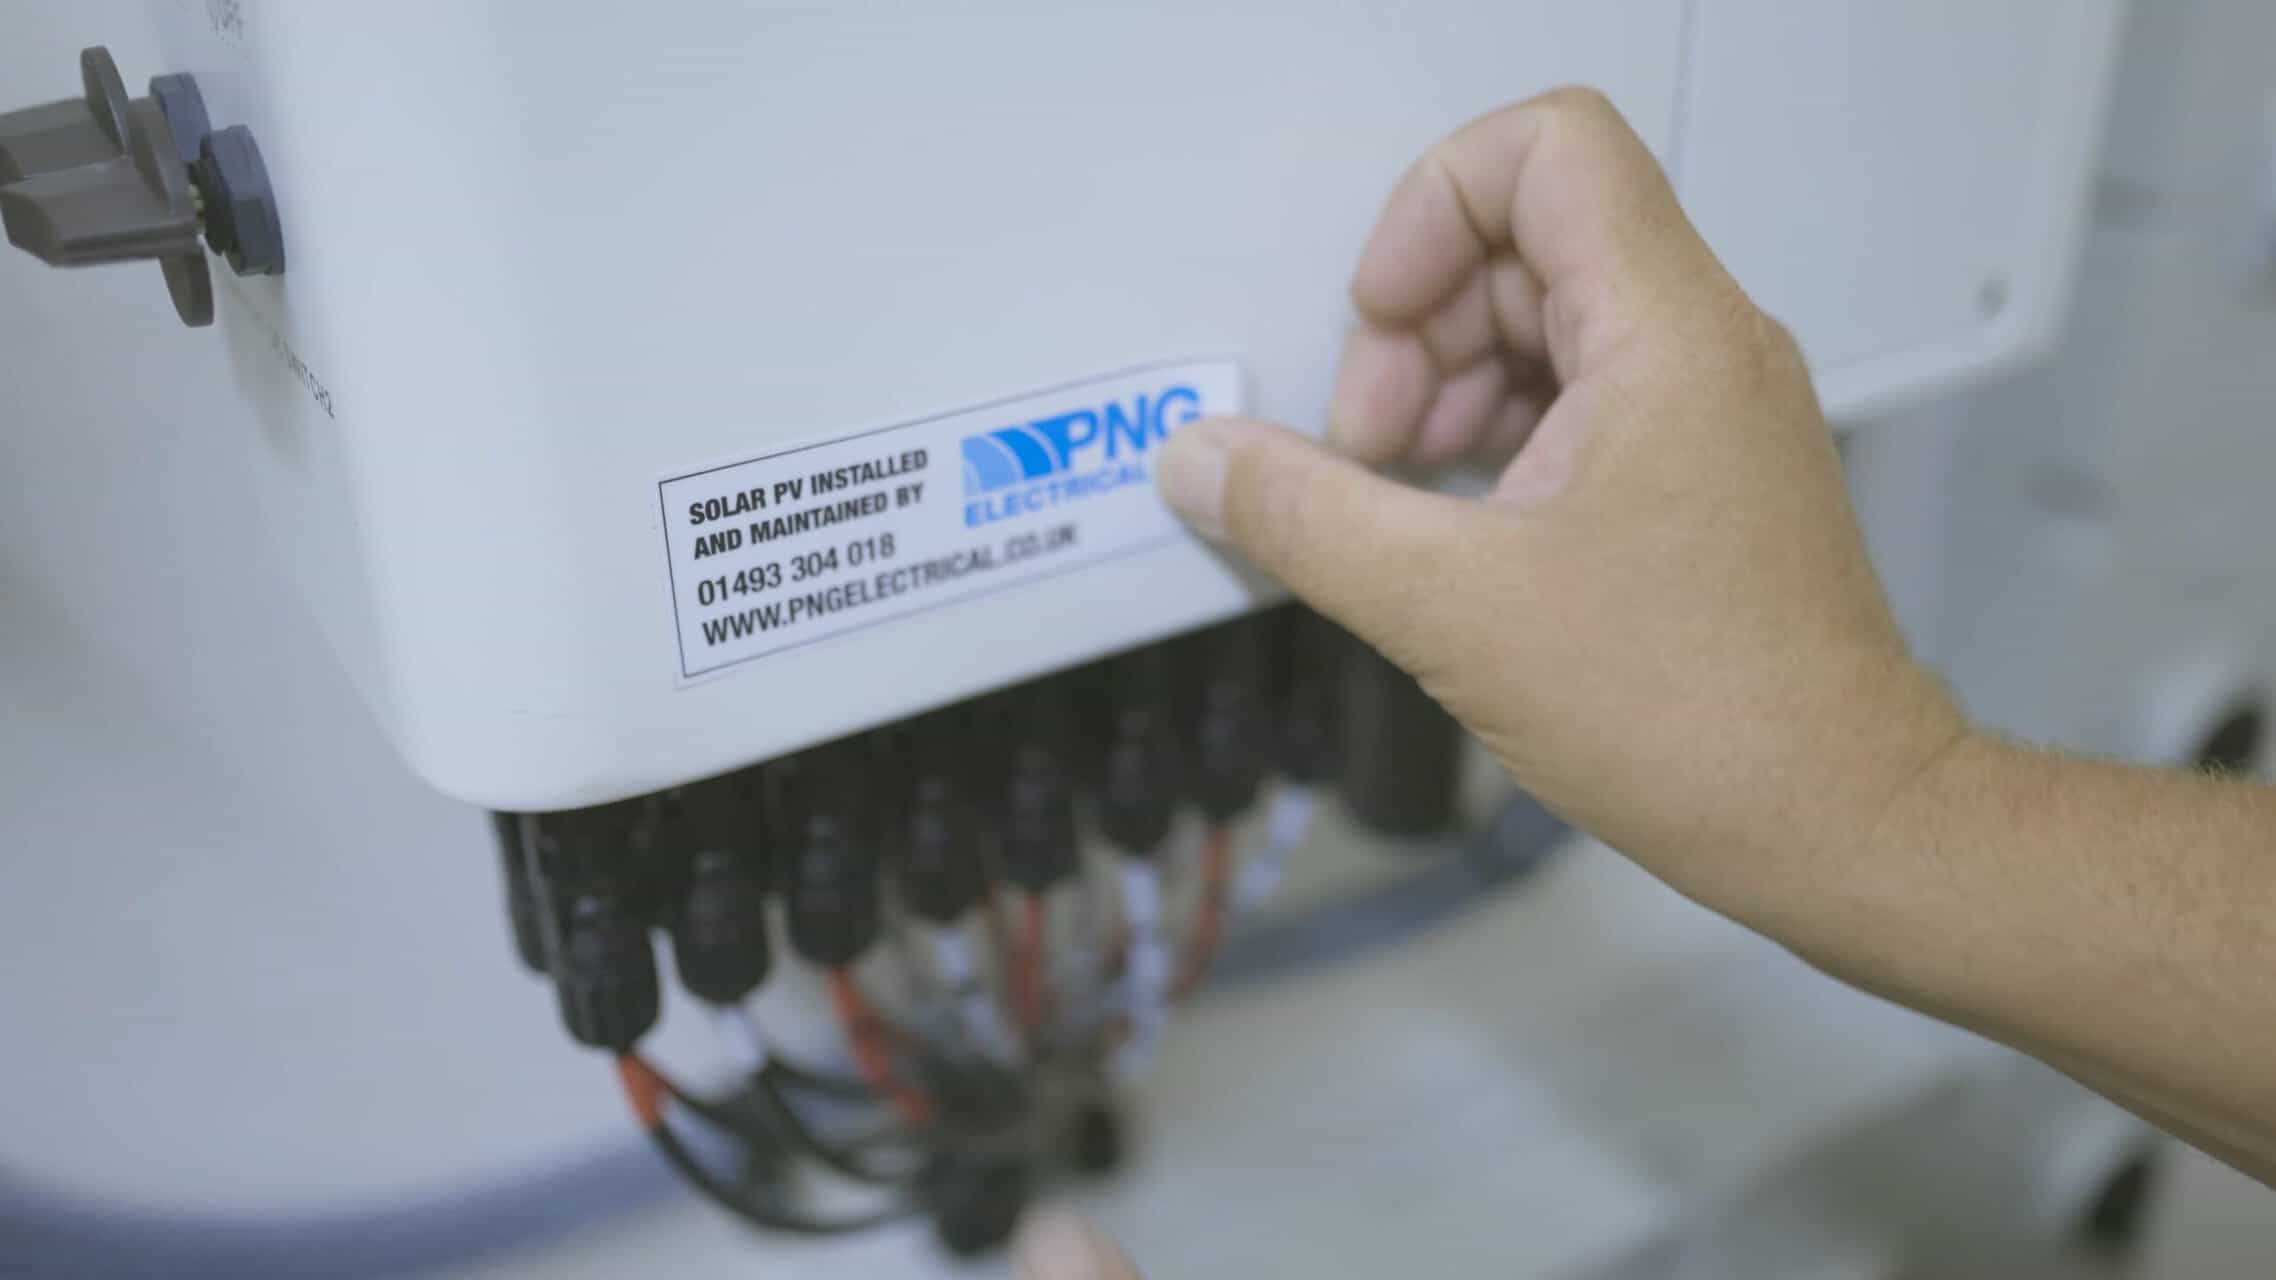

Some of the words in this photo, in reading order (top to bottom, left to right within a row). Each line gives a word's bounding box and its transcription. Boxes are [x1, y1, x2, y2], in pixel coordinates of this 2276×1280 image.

[1031, 386, 1201, 470] PNG
[689, 488, 767, 525] SOLAR
[773, 477, 803, 504] PV
[811, 449, 928, 496] INSTALLED
[694, 528, 742, 560] AND
[750, 491, 888, 545] MAINTAINED
[896, 482, 924, 507] BY
[698, 562, 782, 606] 01493
[791, 546, 839, 582] 304
[847, 532, 895, 566] 018
